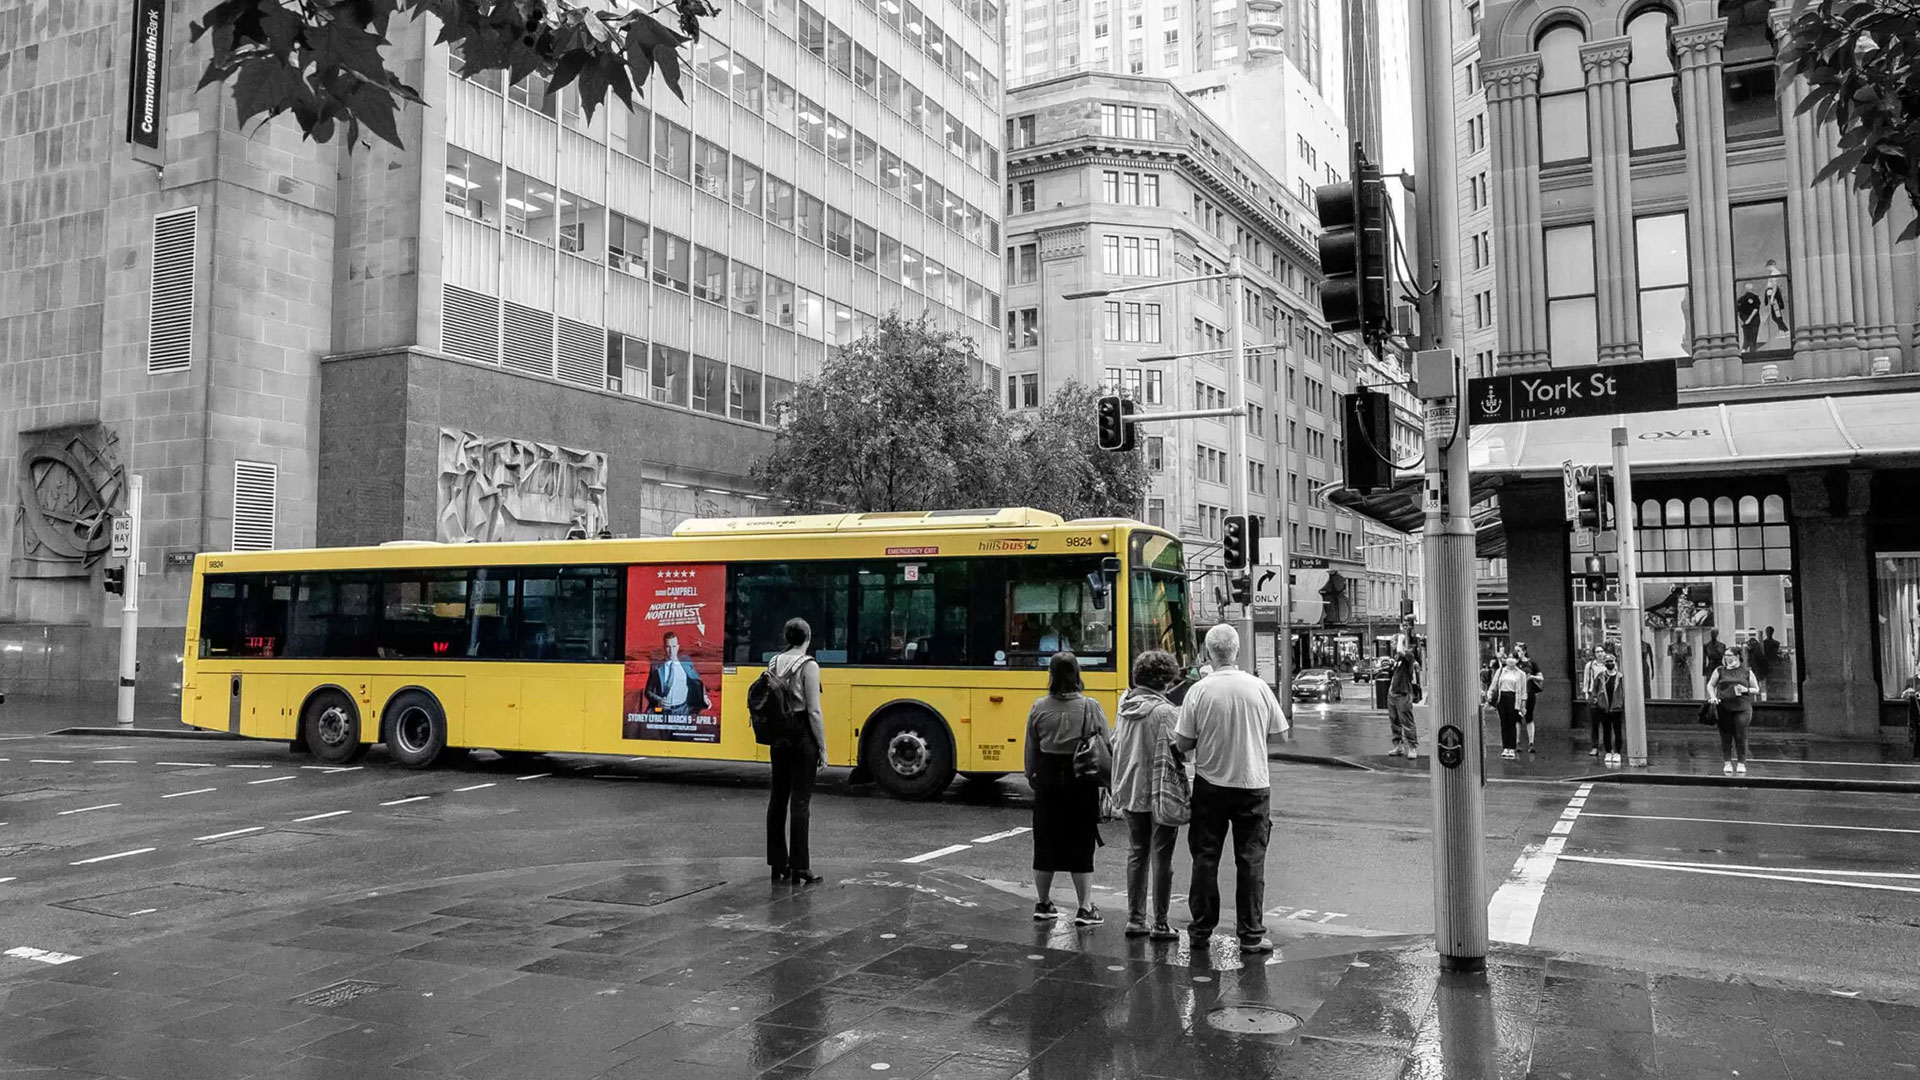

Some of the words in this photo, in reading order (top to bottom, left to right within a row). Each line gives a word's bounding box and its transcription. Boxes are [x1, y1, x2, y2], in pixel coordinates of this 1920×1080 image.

[1520, 376, 1582, 402] York
[1590, 372, 1618, 397] St
[1549, 406, 1566, 417] 149
[1638, 429, 1711, 441] QVB
[115, 520, 129, 530] ONE
[114, 533, 130, 542] WAY
[1066, 537, 1093, 547] 9824
[887, 547, 923, 555] EMERGENCY
[924, 546, 937, 554] EXIT
[978, 540, 1024, 551] hillsbus
[208, 561, 224, 569] 9824
[667, 587, 698, 596] CAMPBELL
[1255, 595, 1279, 603] ONLY
[649, 602, 676, 611] NORTH
[644, 608, 700, 620] NORTHWEST
[628, 713, 648, 722] SYDNEY
[648, 714, 664, 723] LYRIC
[668, 714, 687, 724] MARCH
[696, 716, 712, 725] APRIL
[712, 716, 717, 725] 3
[1264, 906, 1348, 923] EFT
